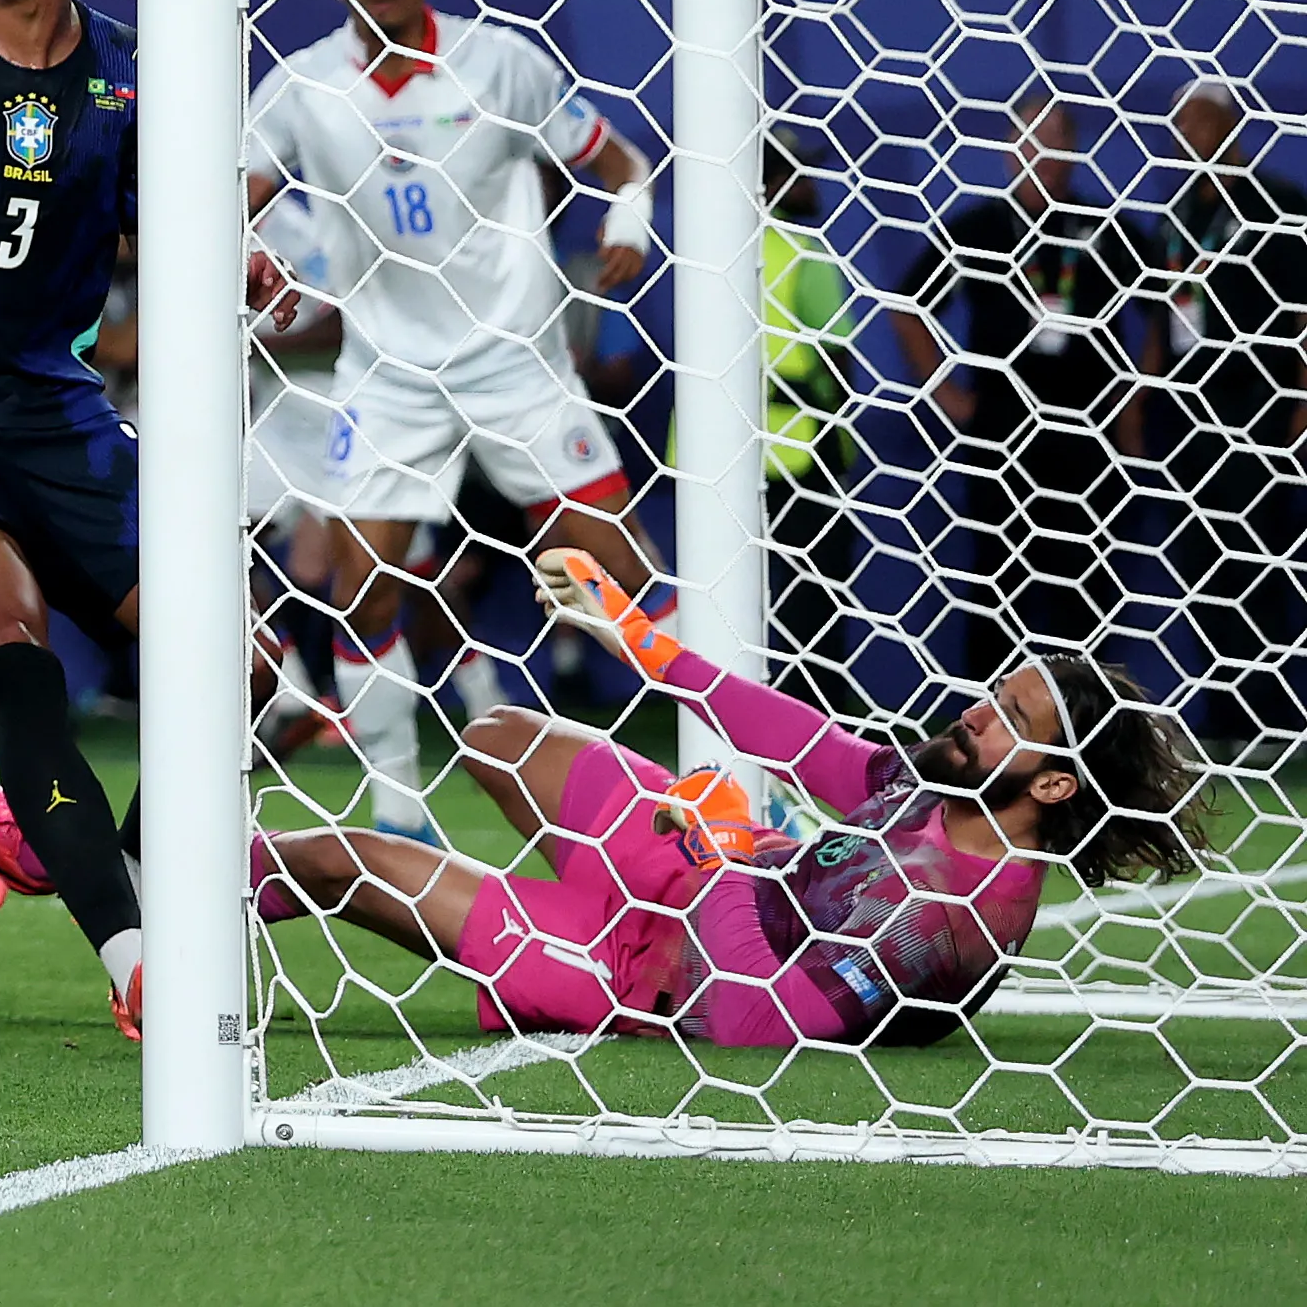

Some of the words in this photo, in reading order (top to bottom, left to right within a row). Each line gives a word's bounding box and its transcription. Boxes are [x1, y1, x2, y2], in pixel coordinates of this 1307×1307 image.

[20, 127, 39, 137] CBF
[3, 164, 53, 183] BRASIL
[384, 181, 433, 236] 18
